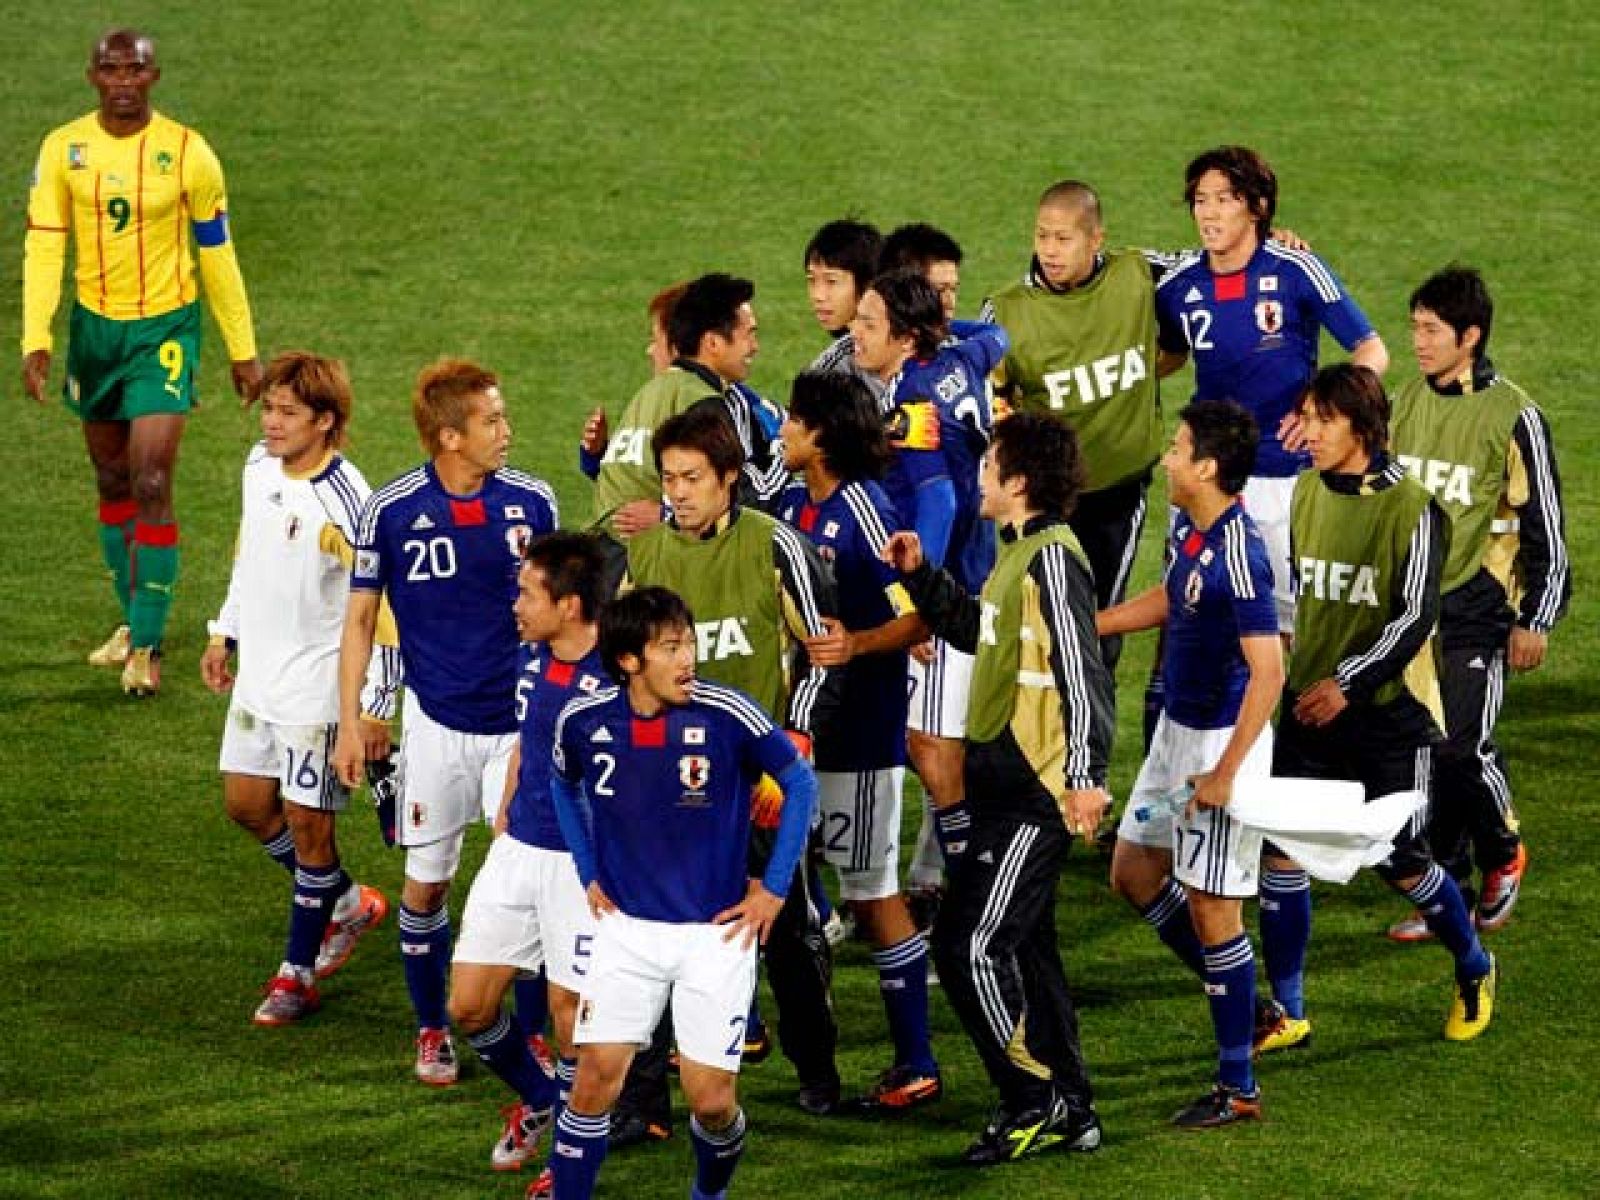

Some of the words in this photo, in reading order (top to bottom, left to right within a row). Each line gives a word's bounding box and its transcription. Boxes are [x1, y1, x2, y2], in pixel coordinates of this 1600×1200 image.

[106, 196, 131, 233] 9
[1180, 309, 1215, 350] 12
[159, 340, 183, 381] 9
[1042, 347, 1146, 410] FIFA
[600, 428, 647, 466] FA
[403, 536, 457, 582] 20
[1299, 556, 1380, 608] FIFA
[695, 617, 756, 662] FA
[515, 677, 535, 721] 5
[285, 746, 319, 790] 16
[592, 753, 616, 797] 2
[819, 811, 851, 852] 2
[1176, 825, 1206, 870] 17
[572, 933, 595, 976] 5
[725, 1014, 746, 1056] 2
